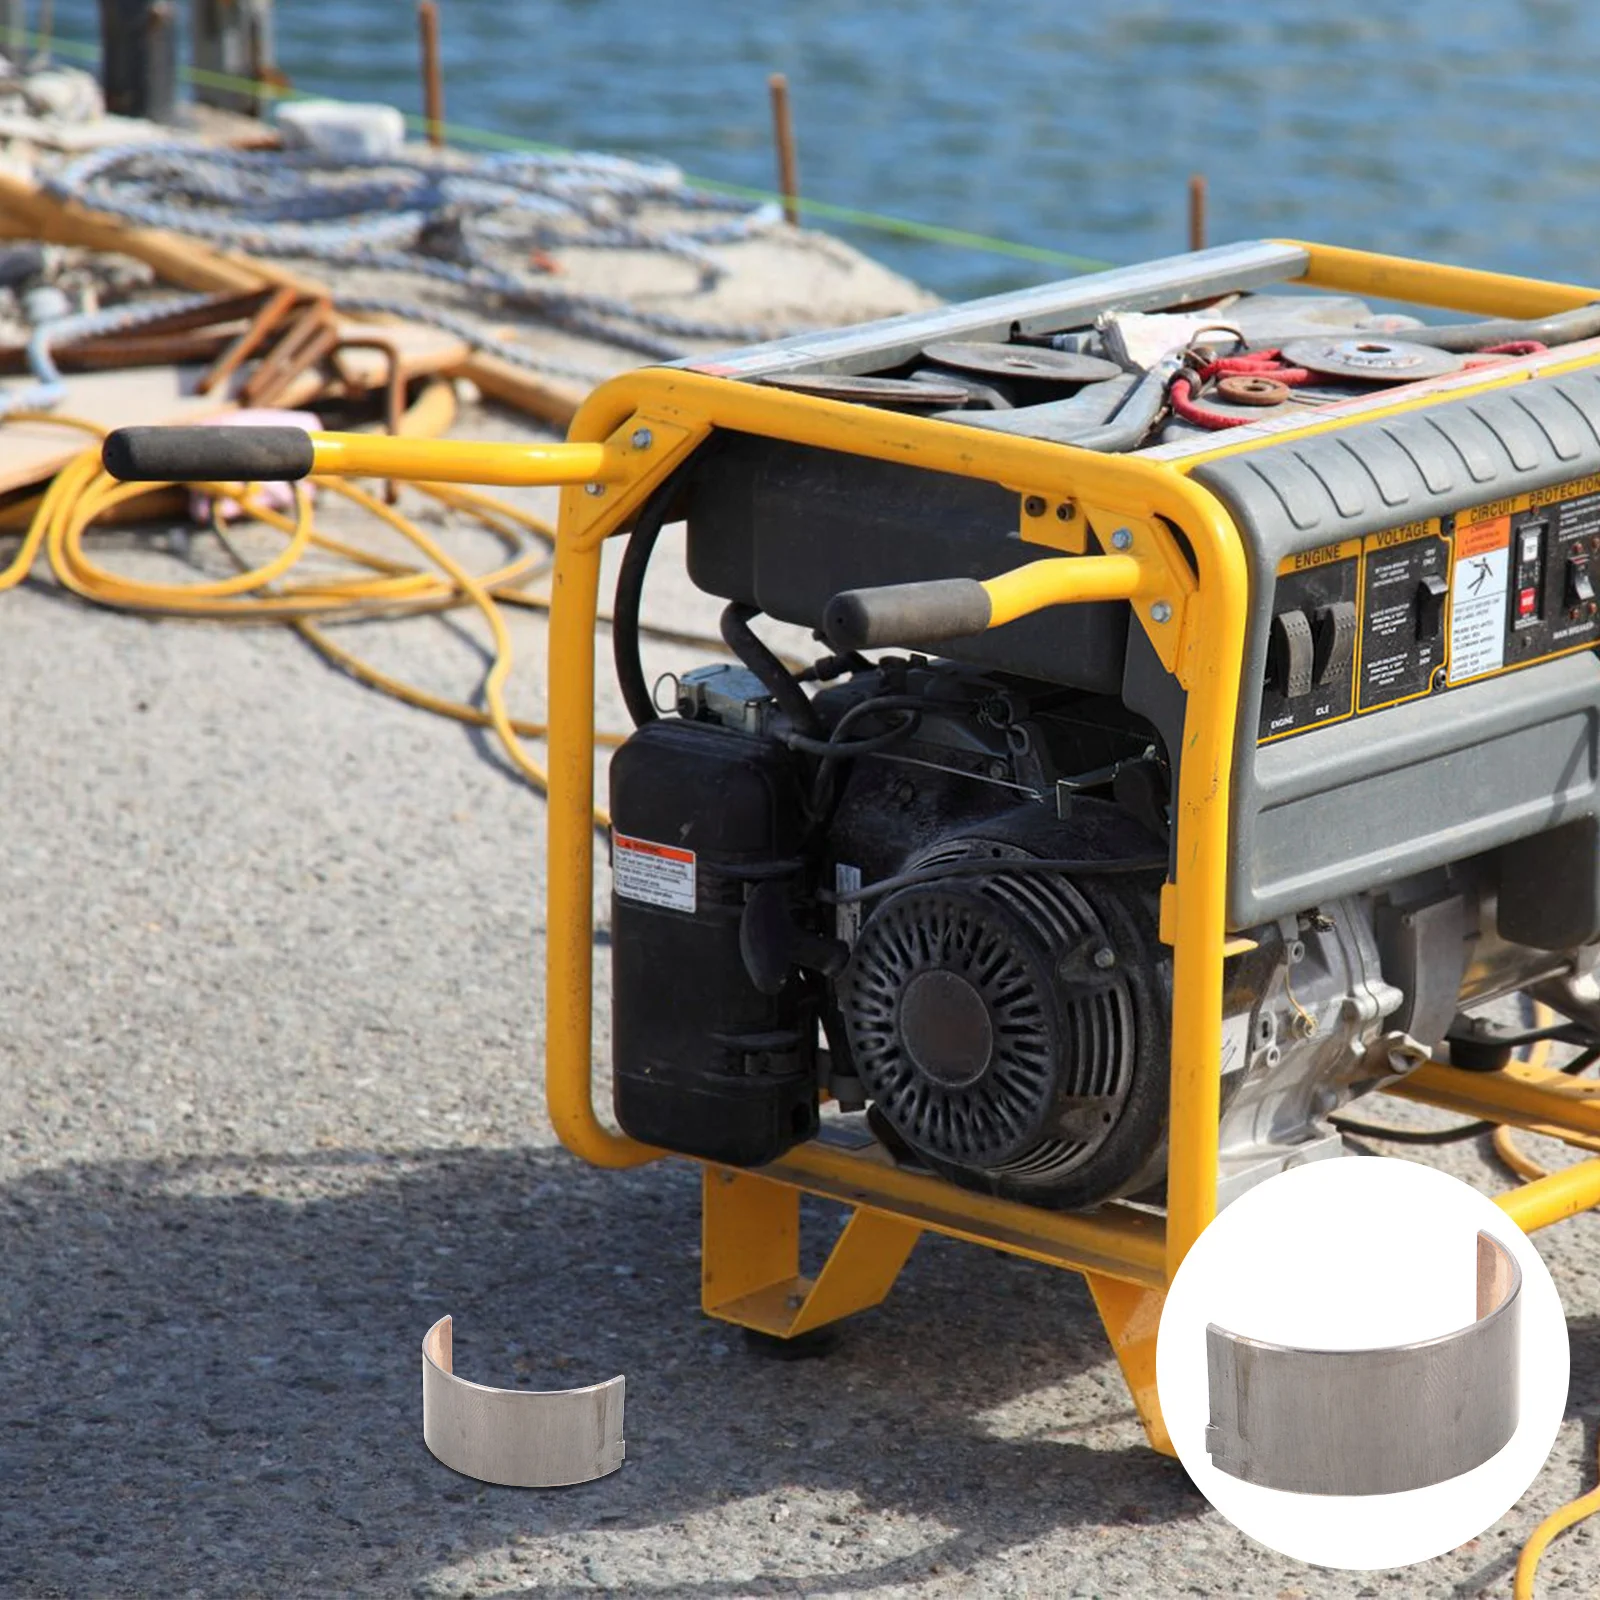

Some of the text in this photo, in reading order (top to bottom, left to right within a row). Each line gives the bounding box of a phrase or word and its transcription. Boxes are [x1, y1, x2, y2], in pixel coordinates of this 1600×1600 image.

[1470, 498, 1517, 521] CIRCUIT
[1377, 522, 1429, 546] VOLTAGE
[1295, 543, 1341, 569] ENGINE
